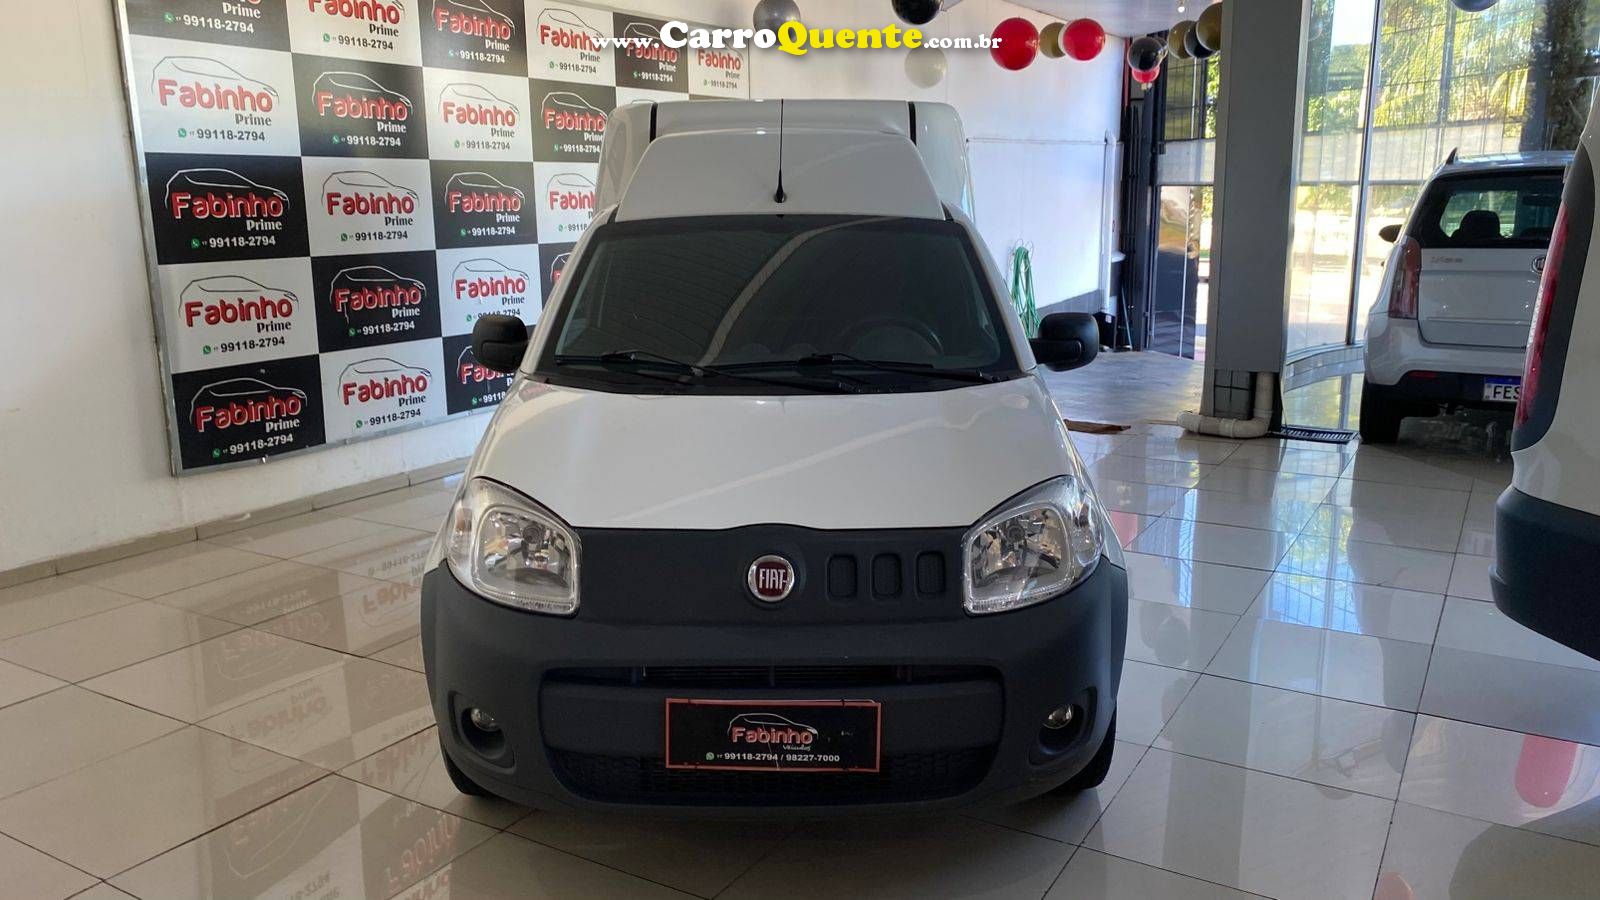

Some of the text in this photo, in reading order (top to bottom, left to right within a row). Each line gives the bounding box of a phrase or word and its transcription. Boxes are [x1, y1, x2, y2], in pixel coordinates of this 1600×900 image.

[222, 2, 261, 18] Prime
[183, 14, 255, 33] 99118-2794
[369, 23, 399, 37] Prime
[435, 7, 512, 41] Fabinho
[338, 35, 394, 50] 99118-2794
[485, 39, 511, 52] Prime
[460, 50, 506, 64] 99118-2794
[580, 52, 601, 62] Prime
[697, 49, 741, 70] Fabinho
[560, 61, 597, 73] 99118-2794
[158, 79, 273, 113] Fabinho
[316, 91, 408, 121] Fabinho
[235, 113, 272, 126] Prime
[442, 101, 516, 127] Fabinho
[544, 108, 605, 132] Fabinho
[196, 128, 266, 142] 99118-2794
[377, 121, 406, 134] Prime
[490, 127, 516, 138] Prime
[346, 135, 402, 147] 99118-2794
[583, 131, 604, 142] Prim
[465, 139, 511, 151] 99118-2794
[171, 191, 284, 220] Fabinho
[326, 191, 415, 216] Fabinho
[449, 191, 521, 213] Fabinho
[246, 219, 283, 231] Prime
[384, 216, 414, 227] Prime
[495, 213, 521, 223] Prime
[355, 230, 408, 242] 99118-2794
[471, 226, 516, 237] 99118-2794
[209, 235, 276, 248] 99118-2794
[455, 275, 527, 299] Fabinho
[335, 286, 422, 313] Fabinho
[501, 296, 525, 306] Prime
[184, 296, 293, 328] Fabinho
[391, 306, 421, 318] Prime
[257, 320, 292, 334] Prime
[362, 320, 415, 336] 99118-2794
[220, 335, 286, 353] 99118-2794
[342, 375, 428, 406] Fabinho
[398, 393, 427, 407] Prime
[194, 395, 302, 432] Fabinho
[369, 408, 421, 426] 99118-2794
[265, 418, 300, 433] Prime
[229, 434, 294, 455] 99118-2794
[759, 568, 786, 589] FIAT
[732, 727, 813, 744] Fabinho
[724, 752, 778, 761] 99118-2794
[786, 754, 840, 762] 98227-7000
